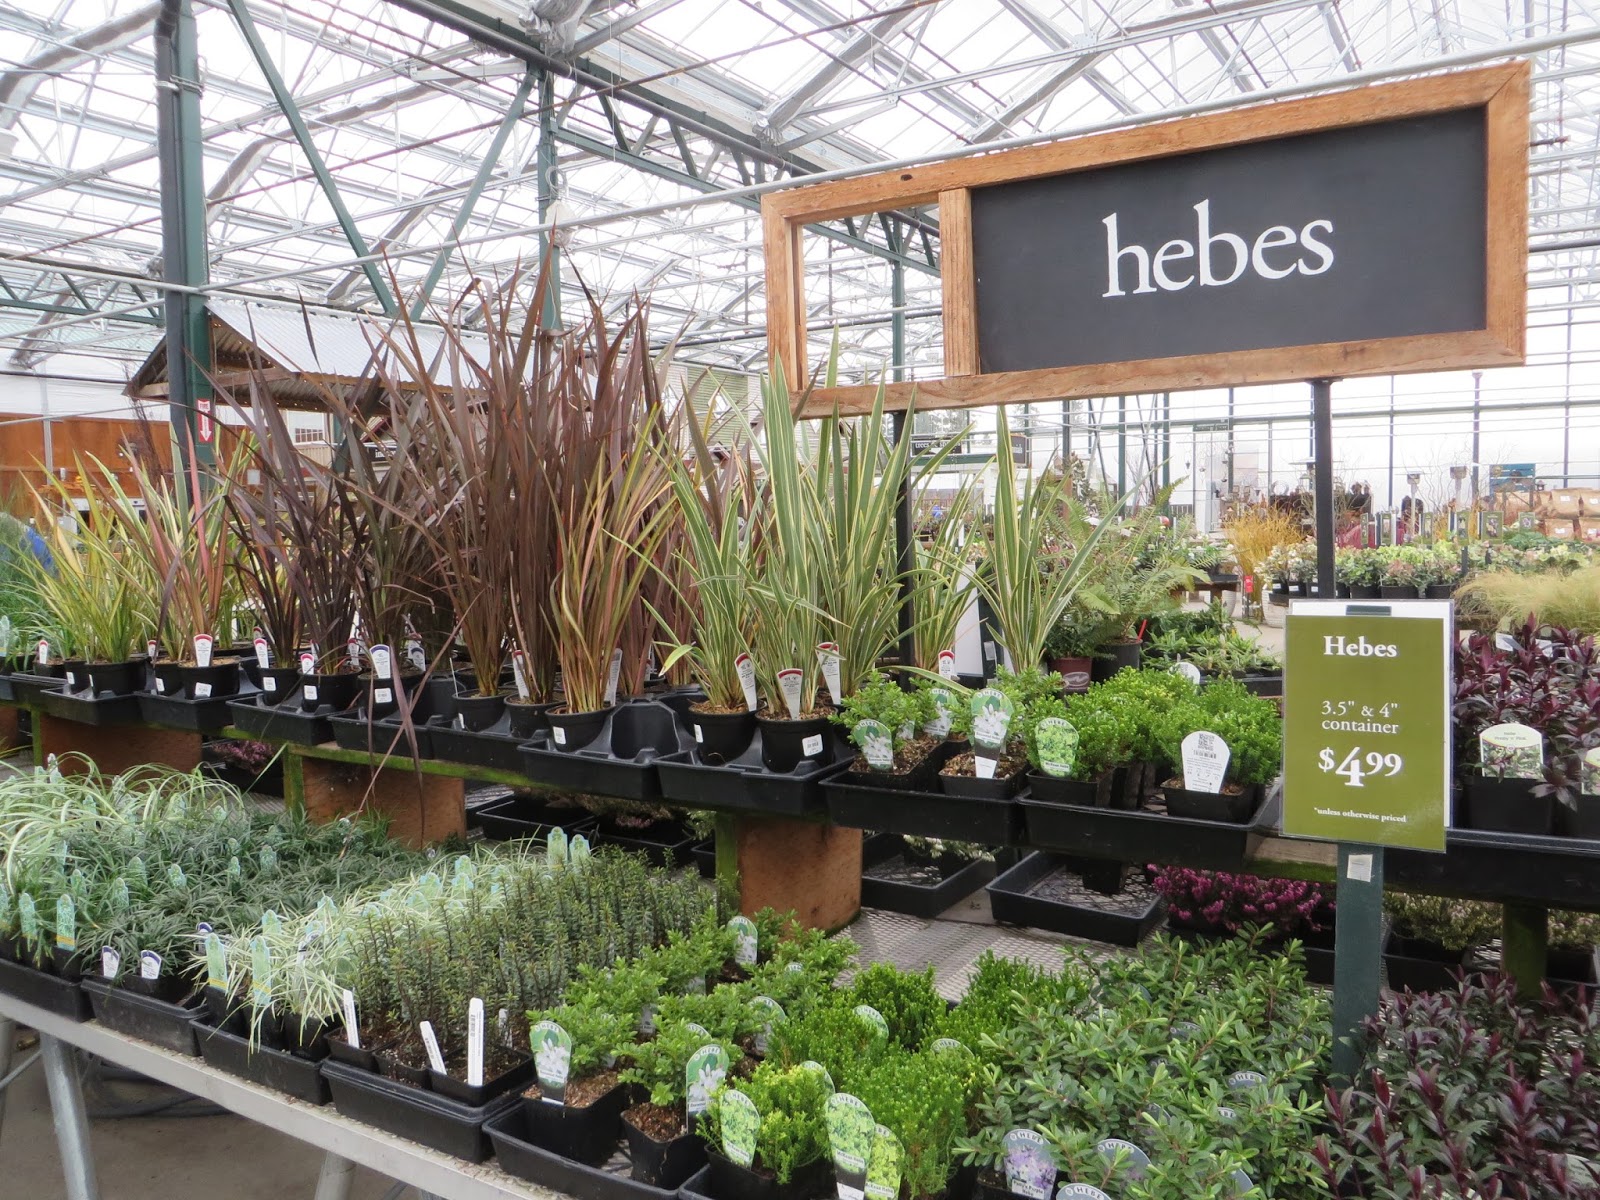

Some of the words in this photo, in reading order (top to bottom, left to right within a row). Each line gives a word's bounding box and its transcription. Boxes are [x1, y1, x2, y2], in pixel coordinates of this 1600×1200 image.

[1102, 199, 1334, 298] hebes
[1323, 636, 1397, 657] Hebes
[1321, 701, 1355, 716] 3.5"
[1361, 705, 1374, 717] &
[1379, 703, 1398, 717] 4"
[1321, 719, 1399, 734] container
[1318, 747, 1402, 787] $499
[1342, 810, 1380, 820] otherwise
[1381, 814, 1407, 823] priced
